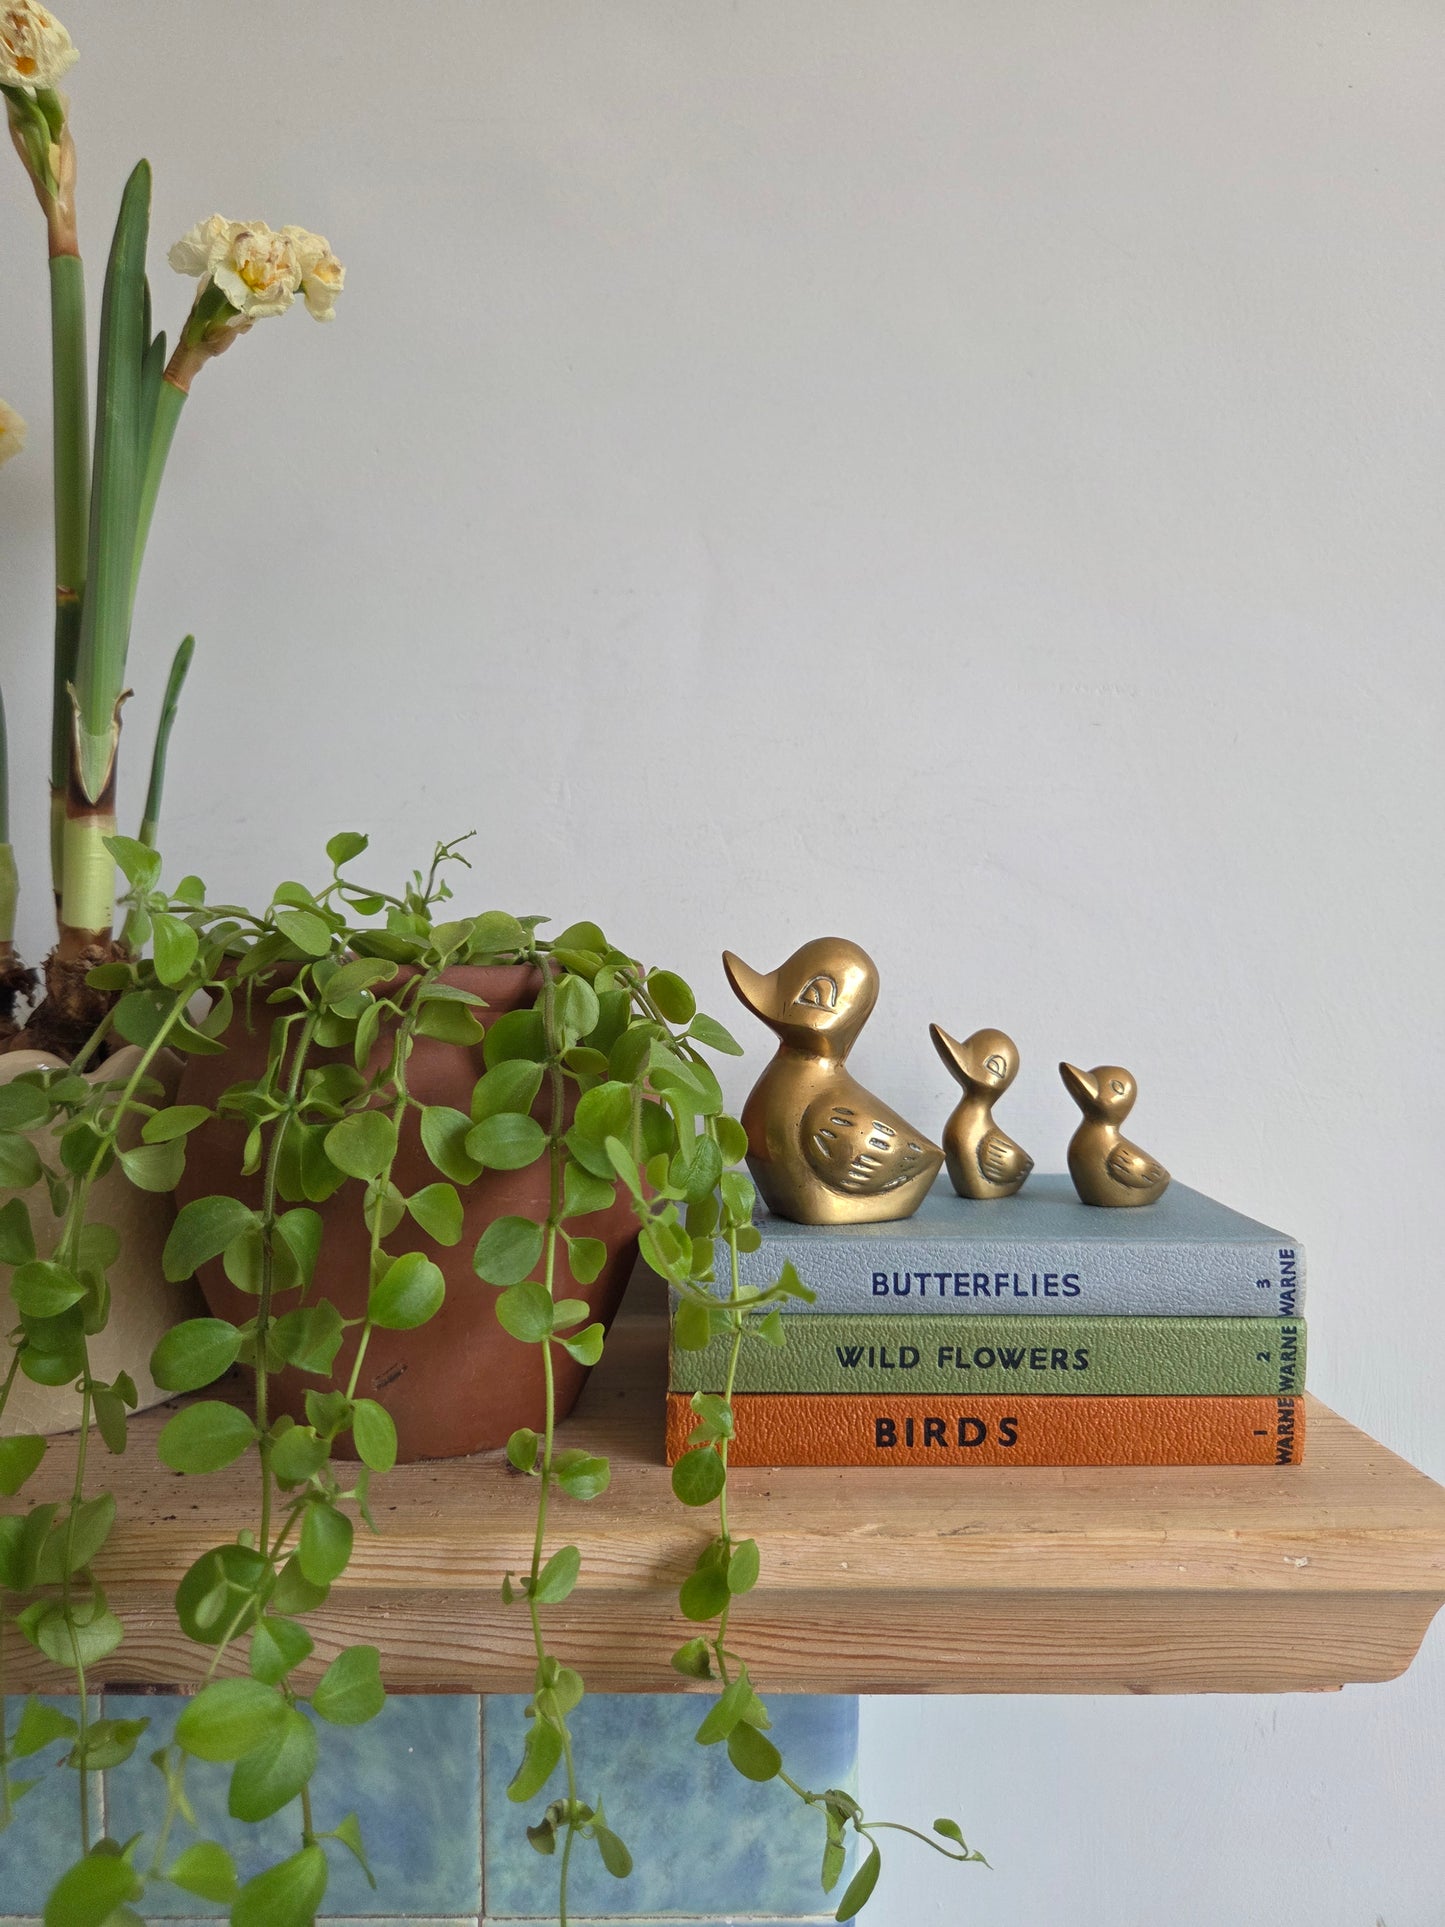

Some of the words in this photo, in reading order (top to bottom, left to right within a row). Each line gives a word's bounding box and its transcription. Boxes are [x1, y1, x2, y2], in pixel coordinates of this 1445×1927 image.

[872, 1273, 1081, 1297] BUTTERFLIES
[1257, 1278, 1271, 1289] 3
[1278, 1248, 1295, 1317] WARNE
[836, 1346, 921, 1369] WILD
[938, 1346, 1089, 1370] FLOWERS
[1257, 1351, 1271, 1362] 2
[1279, 1325, 1297, 1393] WARNE
[875, 1418, 1018, 1447] BIRDS
[1276, 1397, 1295, 1466] WARNE
